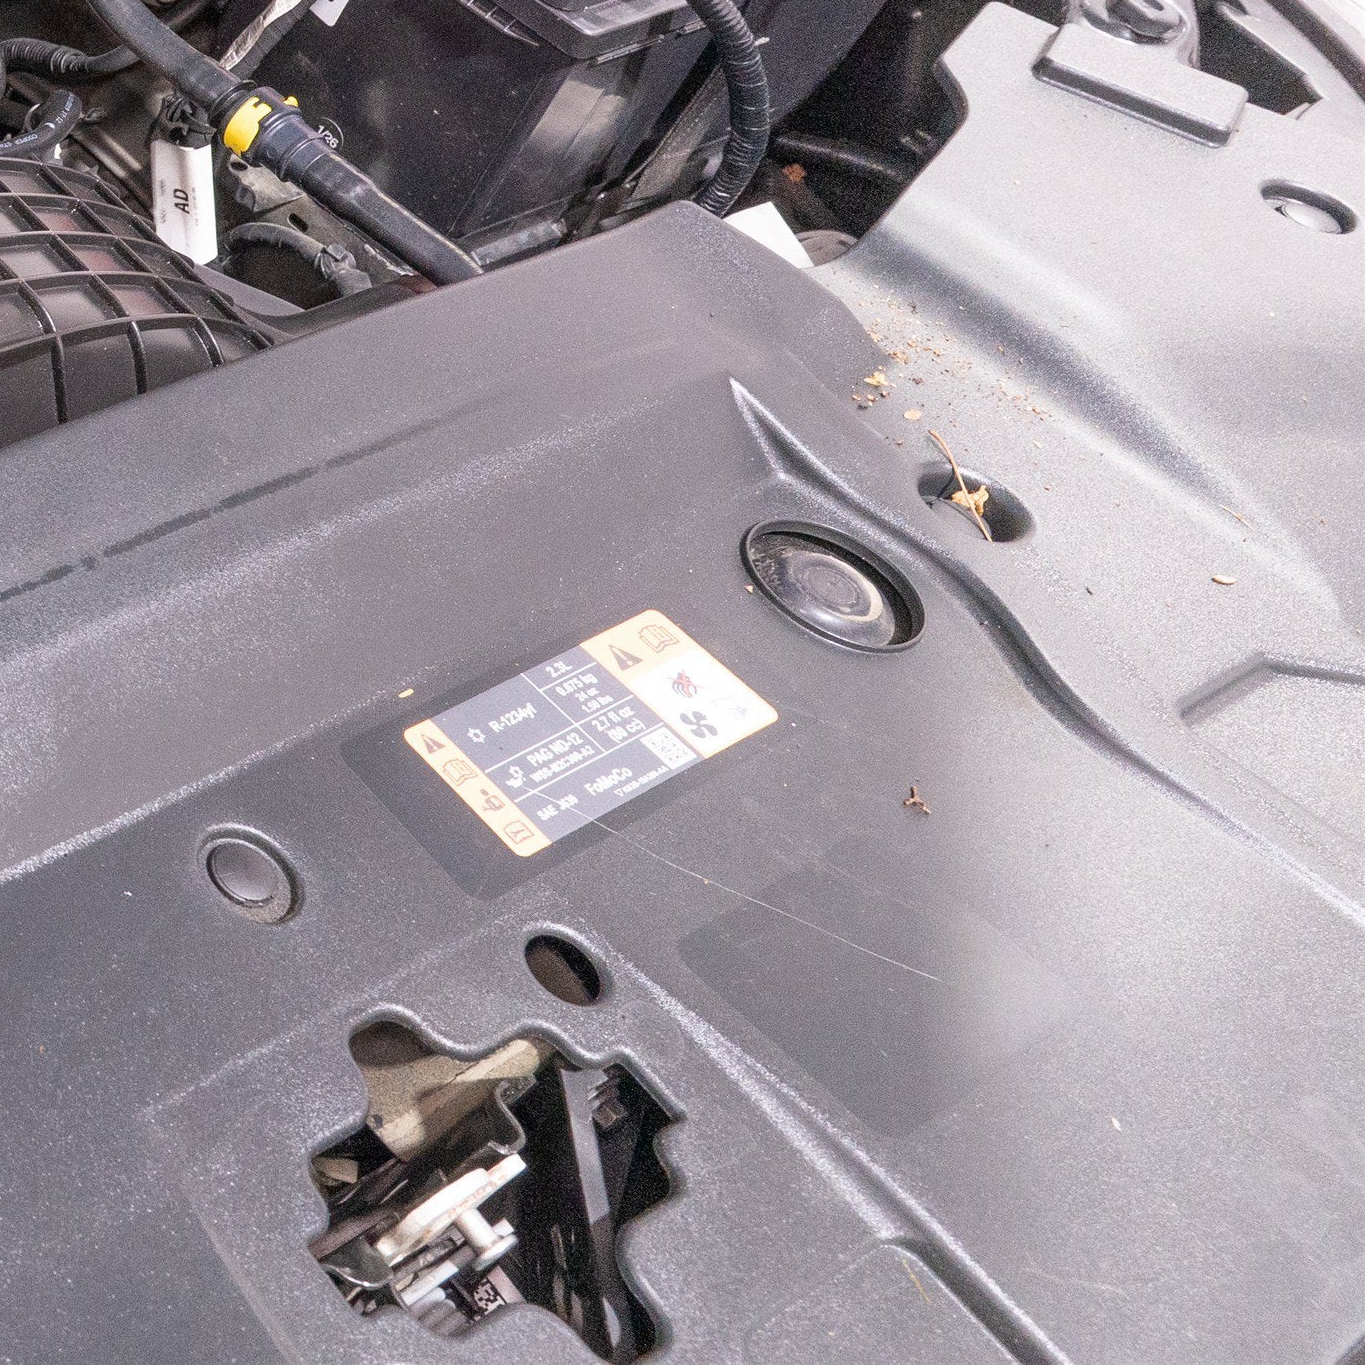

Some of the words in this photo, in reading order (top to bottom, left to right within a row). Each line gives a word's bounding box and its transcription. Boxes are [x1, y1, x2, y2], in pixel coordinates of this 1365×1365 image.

[172, 187, 191, 215] AD
[545, 660, 573, 677] 2.3L
[583, 673, 599, 687] kg
[576, 691, 588, 702] 24
[587, 688, 598, 696] oz
[488, 702, 538, 733] R-1234yf
[592, 717, 609, 731] 2.7
[609, 712, 618, 723] fl
[619, 706, 635, 717] oz
[627, 719, 646, 734] cc)
[528, 750, 551, 767] PAG
[551, 733, 583, 755] ND-12
[585, 767, 633, 796] FoMoCo
[536, 804, 558, 821] SAE
